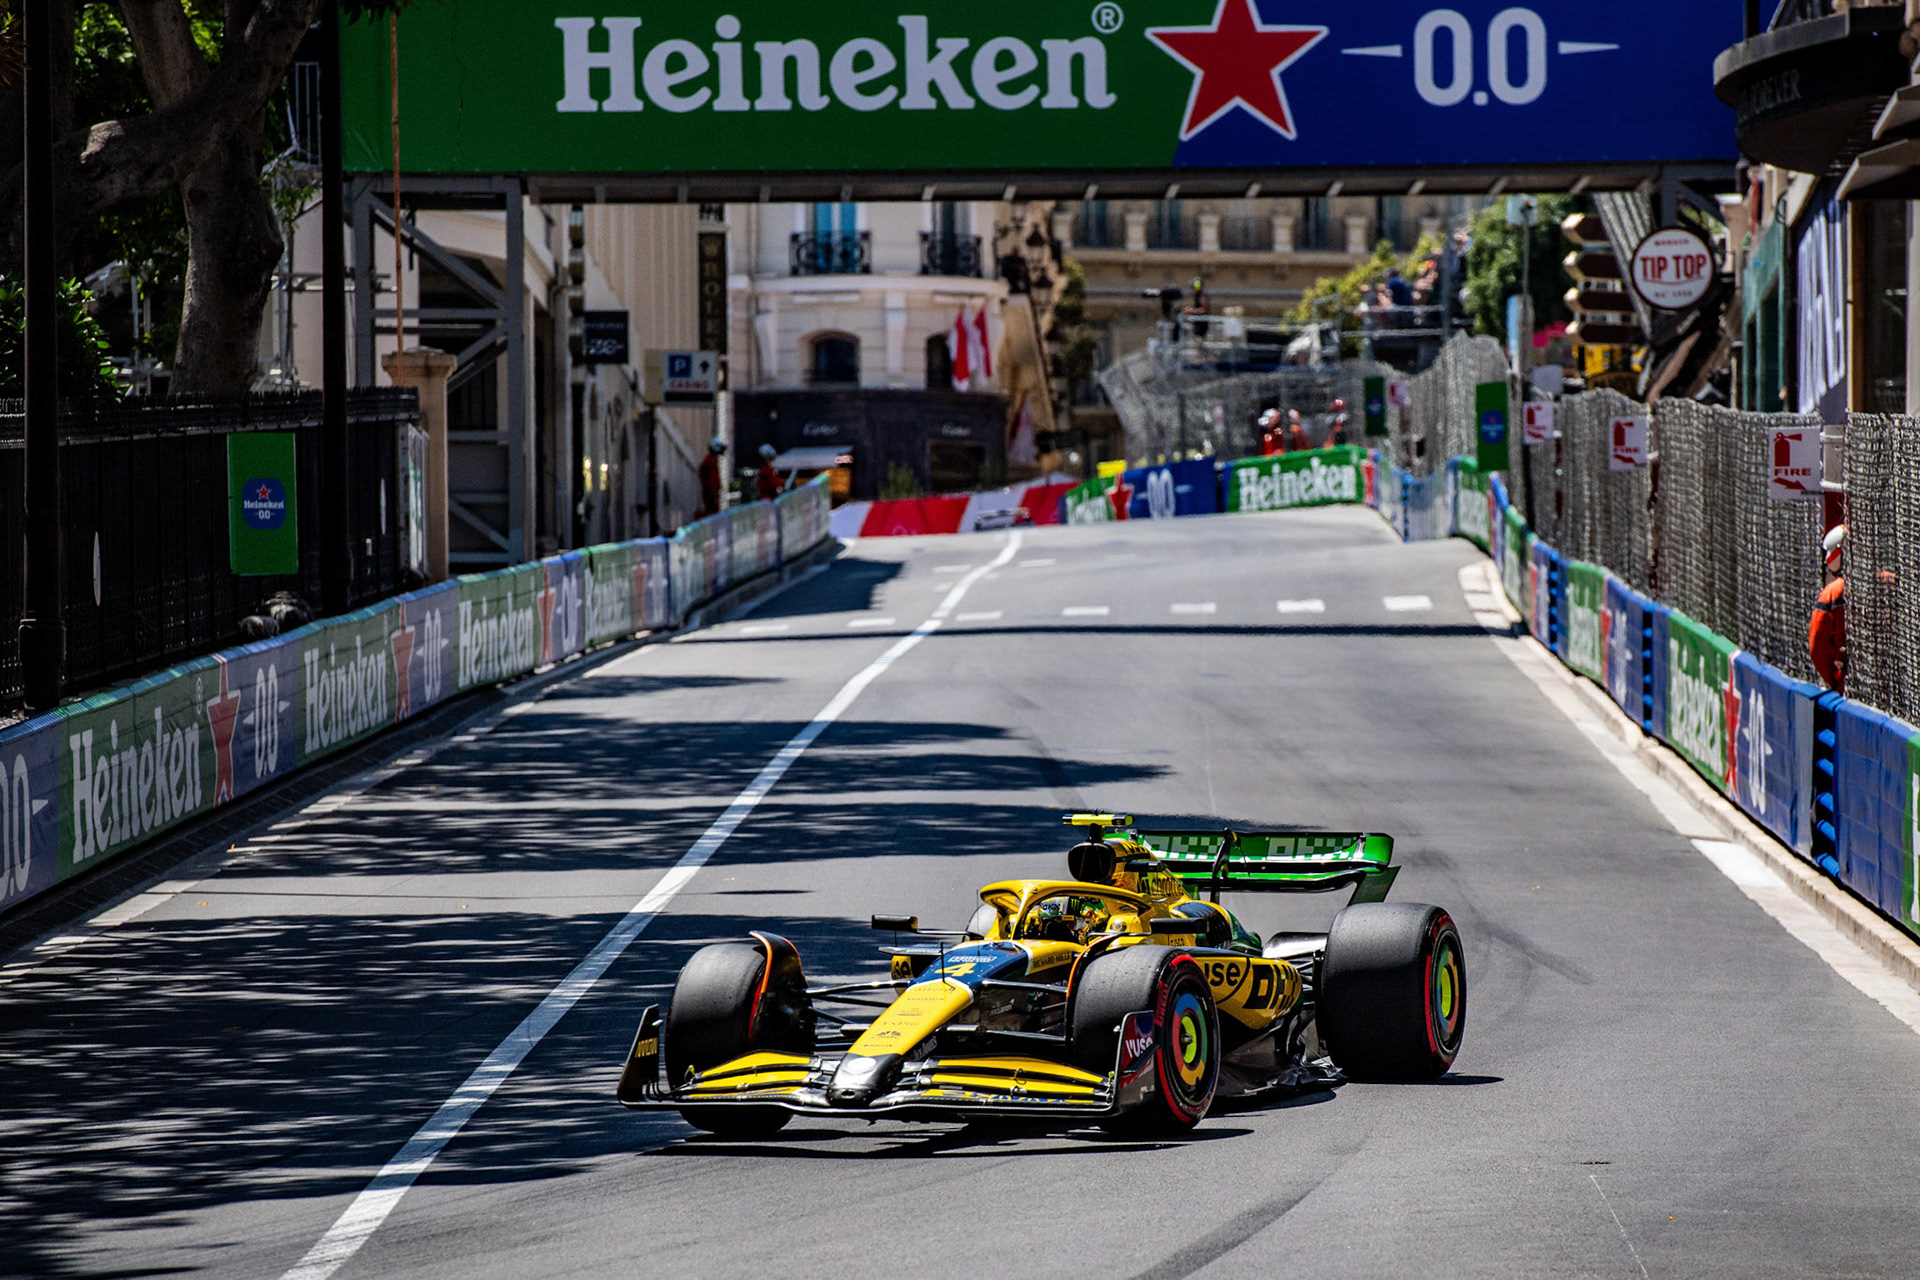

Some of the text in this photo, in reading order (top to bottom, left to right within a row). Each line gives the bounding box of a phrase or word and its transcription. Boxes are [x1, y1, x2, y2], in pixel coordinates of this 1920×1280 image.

[1414, 7, 1547, 107] 0.0
[1640, 253, 1707, 280] TIP TOP
[1613, 446, 1640, 454] FIRE
[1237, 457, 1357, 511] Heineken
[1773, 467, 1812, 477] FIRE
[243, 500, 285, 509] Heineken
[458, 591, 535, 689] Heineken
[304, 634, 388, 755] Heineken
[69, 706, 202, 864] Heineken
[934, 962, 977, 977] 4
[1033, 952, 1071, 969] RICHARD MILLE
